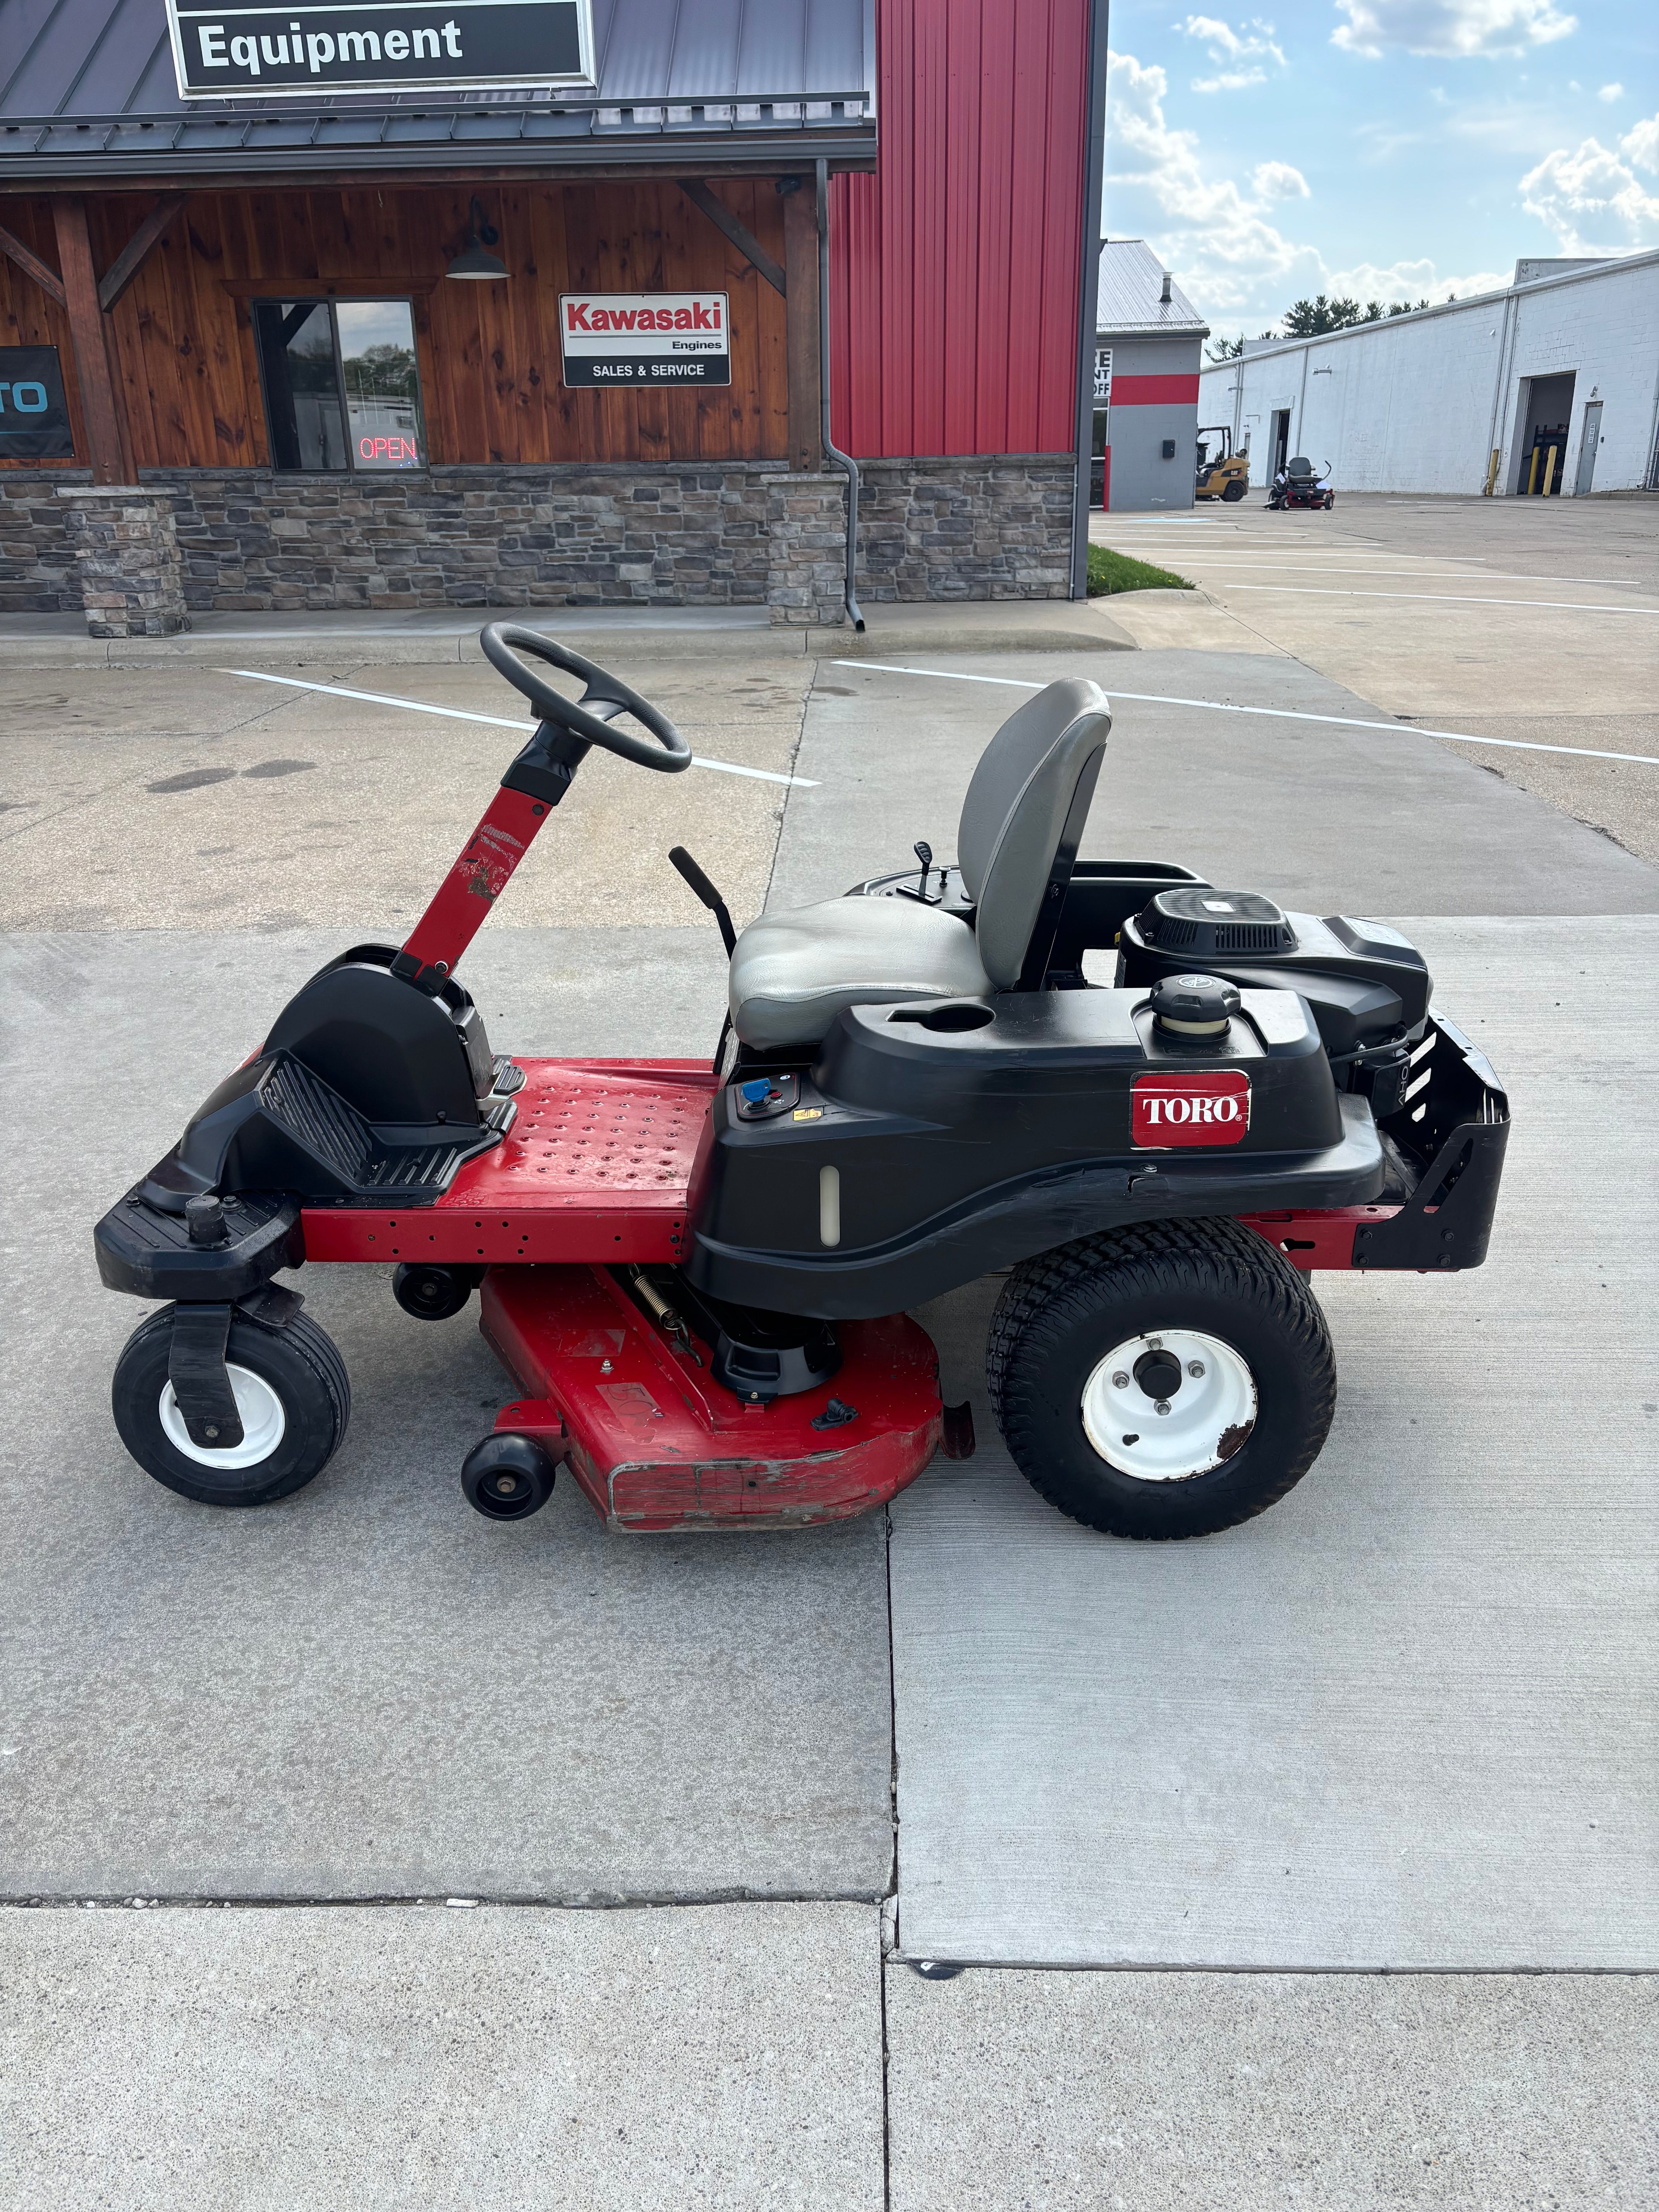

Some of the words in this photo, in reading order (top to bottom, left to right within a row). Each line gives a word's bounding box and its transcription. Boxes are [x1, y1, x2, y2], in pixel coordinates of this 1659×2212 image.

[198, 19, 463, 75] Equipment
[567, 302, 721, 331] Kawasaki
[672, 341, 722, 351] Engines
[593, 365, 633, 376] SALES
[638, 366, 646, 376] &
[651, 364, 704, 376] SERVICE
[359, 437, 416, 460] OPEN
[1398, 1065, 1408, 1106] OHV
